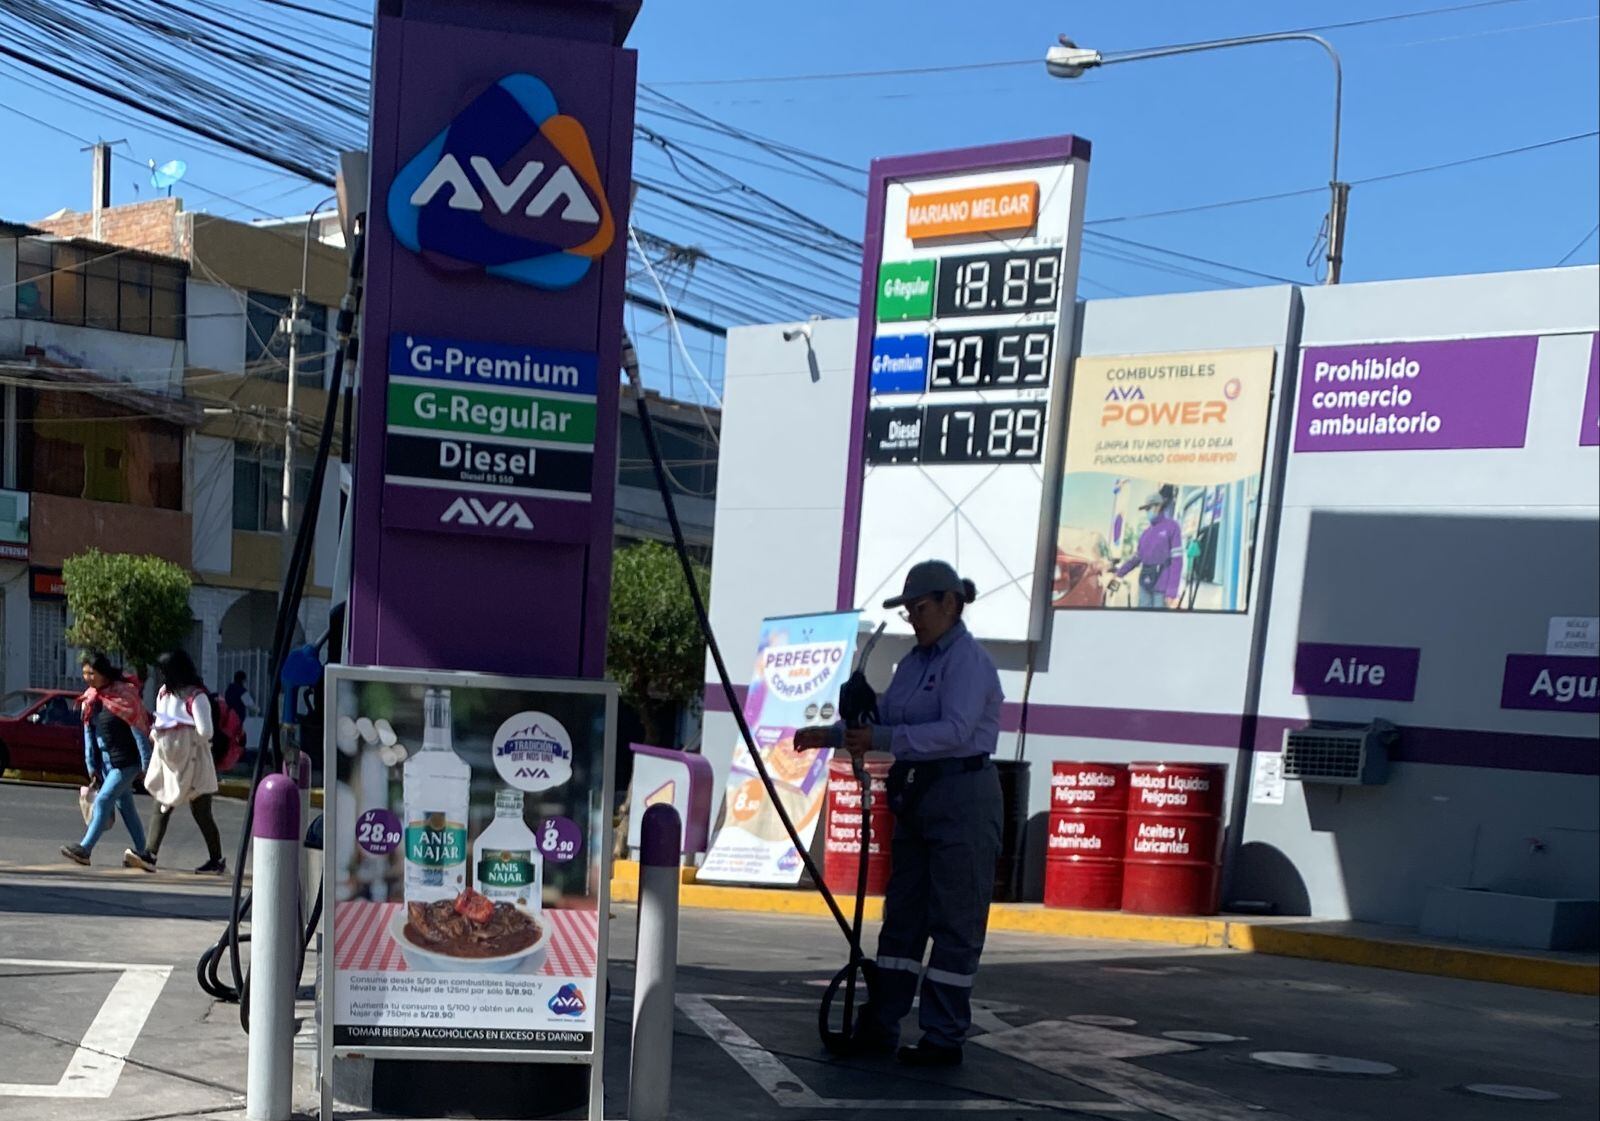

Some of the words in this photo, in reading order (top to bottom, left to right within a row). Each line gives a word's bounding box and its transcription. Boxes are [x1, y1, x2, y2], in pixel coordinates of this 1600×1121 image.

[410, 153, 599, 223] AVA
[908, 201, 969, 225] MARIANO
[971, 194, 1030, 219] MELGAR
[884, 276, 929, 299] G-Regular
[955, 257, 1058, 309] 18.89
[410, 345, 579, 386] G-Premium
[873, 353, 923, 374] G-Premium
[932, 334, 1049, 386] 20.59
[1315, 357, 1420, 382] Prohibido
[1107, 363, 1216, 381] COMBUSTIBLES
[1105, 385, 1145, 401] AVA
[1312, 385, 1412, 409] comercio
[414, 393, 571, 433] G-Regular
[1101, 400, 1228, 428] POWER
[889, 419, 921, 440] Diesel
[941, 408, 1041, 457] 17.89
[1309, 411, 1441, 436] ambulatorio
[1132, 439, 1144, 450] TU
[1146, 438, 1181, 449] MOTOR
[1184, 438, 1192, 449] Y
[1192, 438, 1206, 449] LO
[1207, 437, 1233, 448] DEJA
[440, 442, 536, 475] Diesel
[1094, 453, 1164, 465] FUNCIONANDO
[1166, 452, 1196, 463] COMO
[441, 497, 534, 529] AVA
[766, 648, 842, 668] PERFECTO
[772, 667, 830, 696] COMPARTIR
[1324, 658, 1385, 685] Aire
[1530, 669, 1598, 702] Agu
[514, 767, 550, 778] AVA
[1168, 775, 1209, 792] Líquidos
[1141, 788, 1187, 807] Peligroso
[359, 823, 401, 843] 28.90
[1058, 819, 1085, 834] Arena
[1138, 823, 1175, 838] Aceites
[1178, 828, 1186, 841] y
[419, 831, 455, 845] ANIS
[542, 829, 574, 852] 8.90
[1134, 837, 1189, 854] Lubricantes
[413, 845, 460, 862] NAJAR
[488, 872, 522, 883] NAJAR
[493, 863, 518, 873] ANIS
[350, 976, 387, 984] Consume
[390, 976, 414, 984] desde
[451, 979, 503, 987] combustibles
[410, 986, 431, 994] Najar
[552, 997, 584, 1006] AVA
[348, 1027, 380, 1036] TOMAR
[382, 1028, 419, 1037] BEBIDAS
[486, 1030, 498, 1039] EN
[500, 1031, 534, 1040] EXCESO
[536, 1032, 546, 1040] ES
[548, 1032, 584, 1041] DAÑINO
